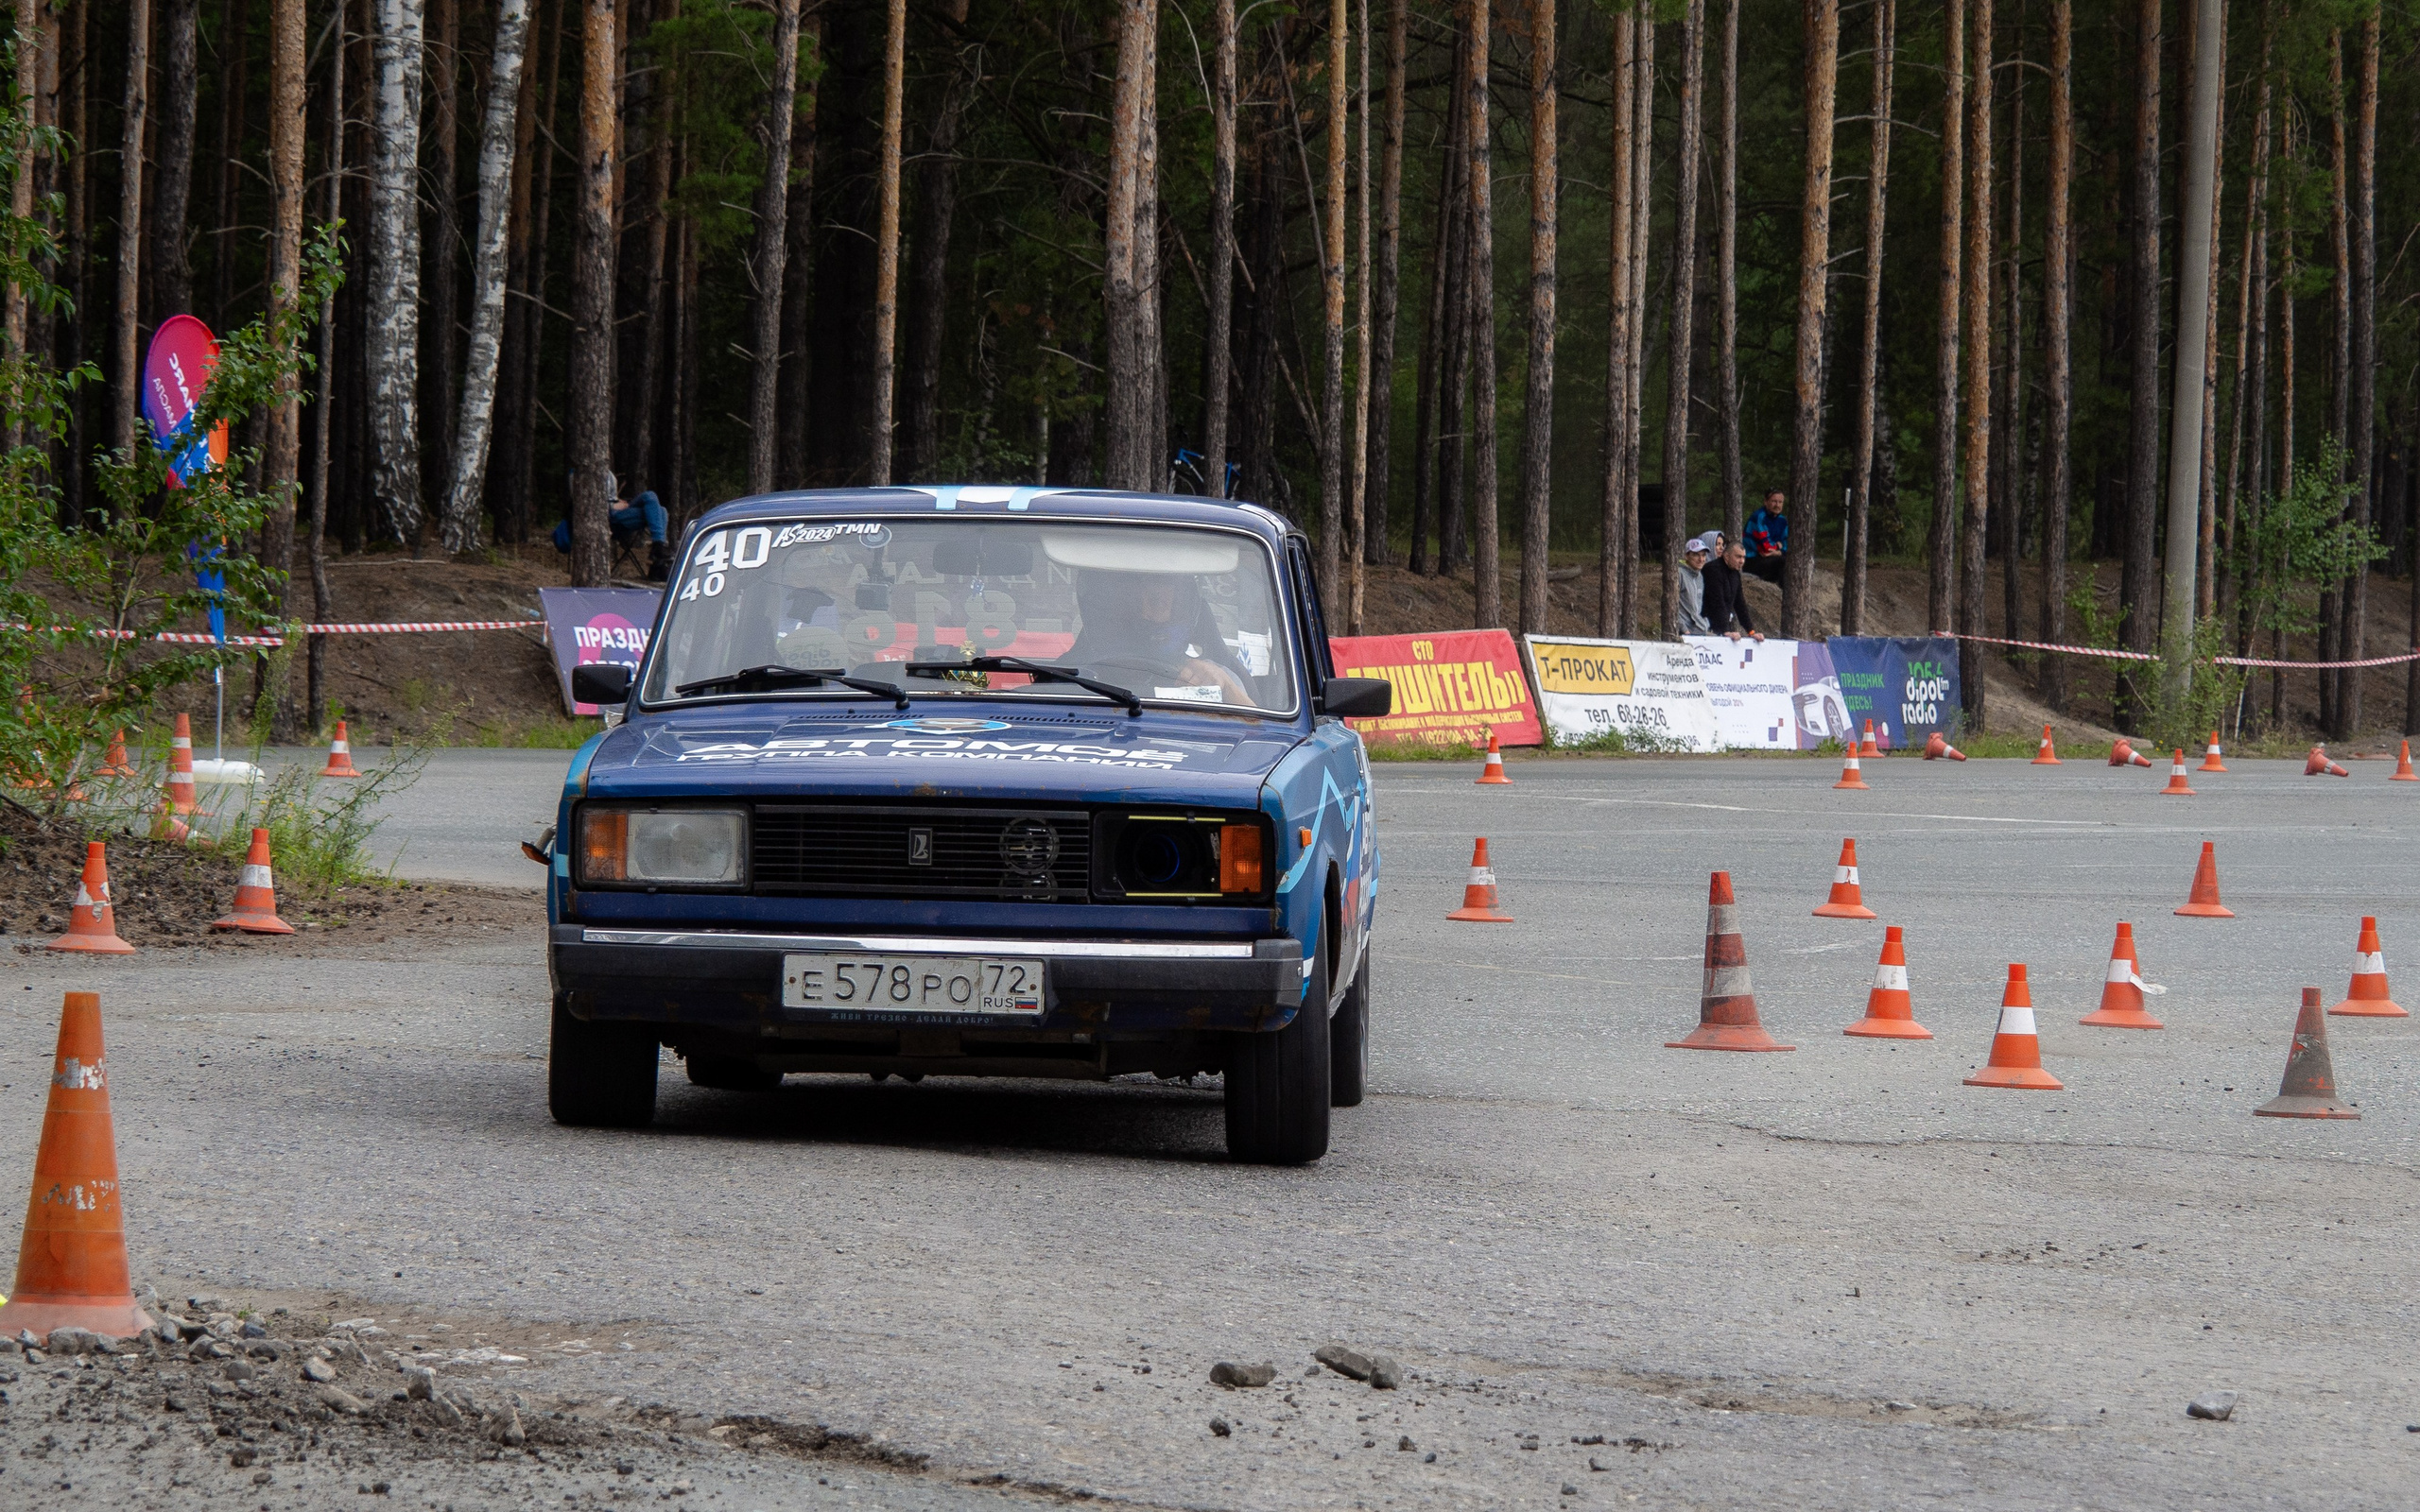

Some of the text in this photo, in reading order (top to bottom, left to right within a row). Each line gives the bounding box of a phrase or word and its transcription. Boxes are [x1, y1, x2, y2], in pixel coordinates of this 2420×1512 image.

[796, 528, 832, 541] 2024
[835, 524, 881, 534] TMN
[695, 526, 772, 574] 40
[680, 573, 725, 602] 40
[1411, 640, 1434, 661] СТО
[1695, 652, 1723, 665] ЛААС
[1540, 656, 1627, 682] Т-ПРОКАТ
[1666, 655, 1694, 669] Аренда
[1647, 672, 1700, 685] инструментов
[1840, 672, 1885, 690] ПРАЗДНИК
[1634, 687, 1704, 699] и садовой техники
[1906, 676, 1944, 703] dipol
[1584, 704, 1668, 727] тел. 68-26-26
[1901, 702, 1937, 725] radio
[676, 750, 869, 762] ГРУППА
[987, 964, 1027, 995] 72
[983, 997, 1014, 1008] RUS
